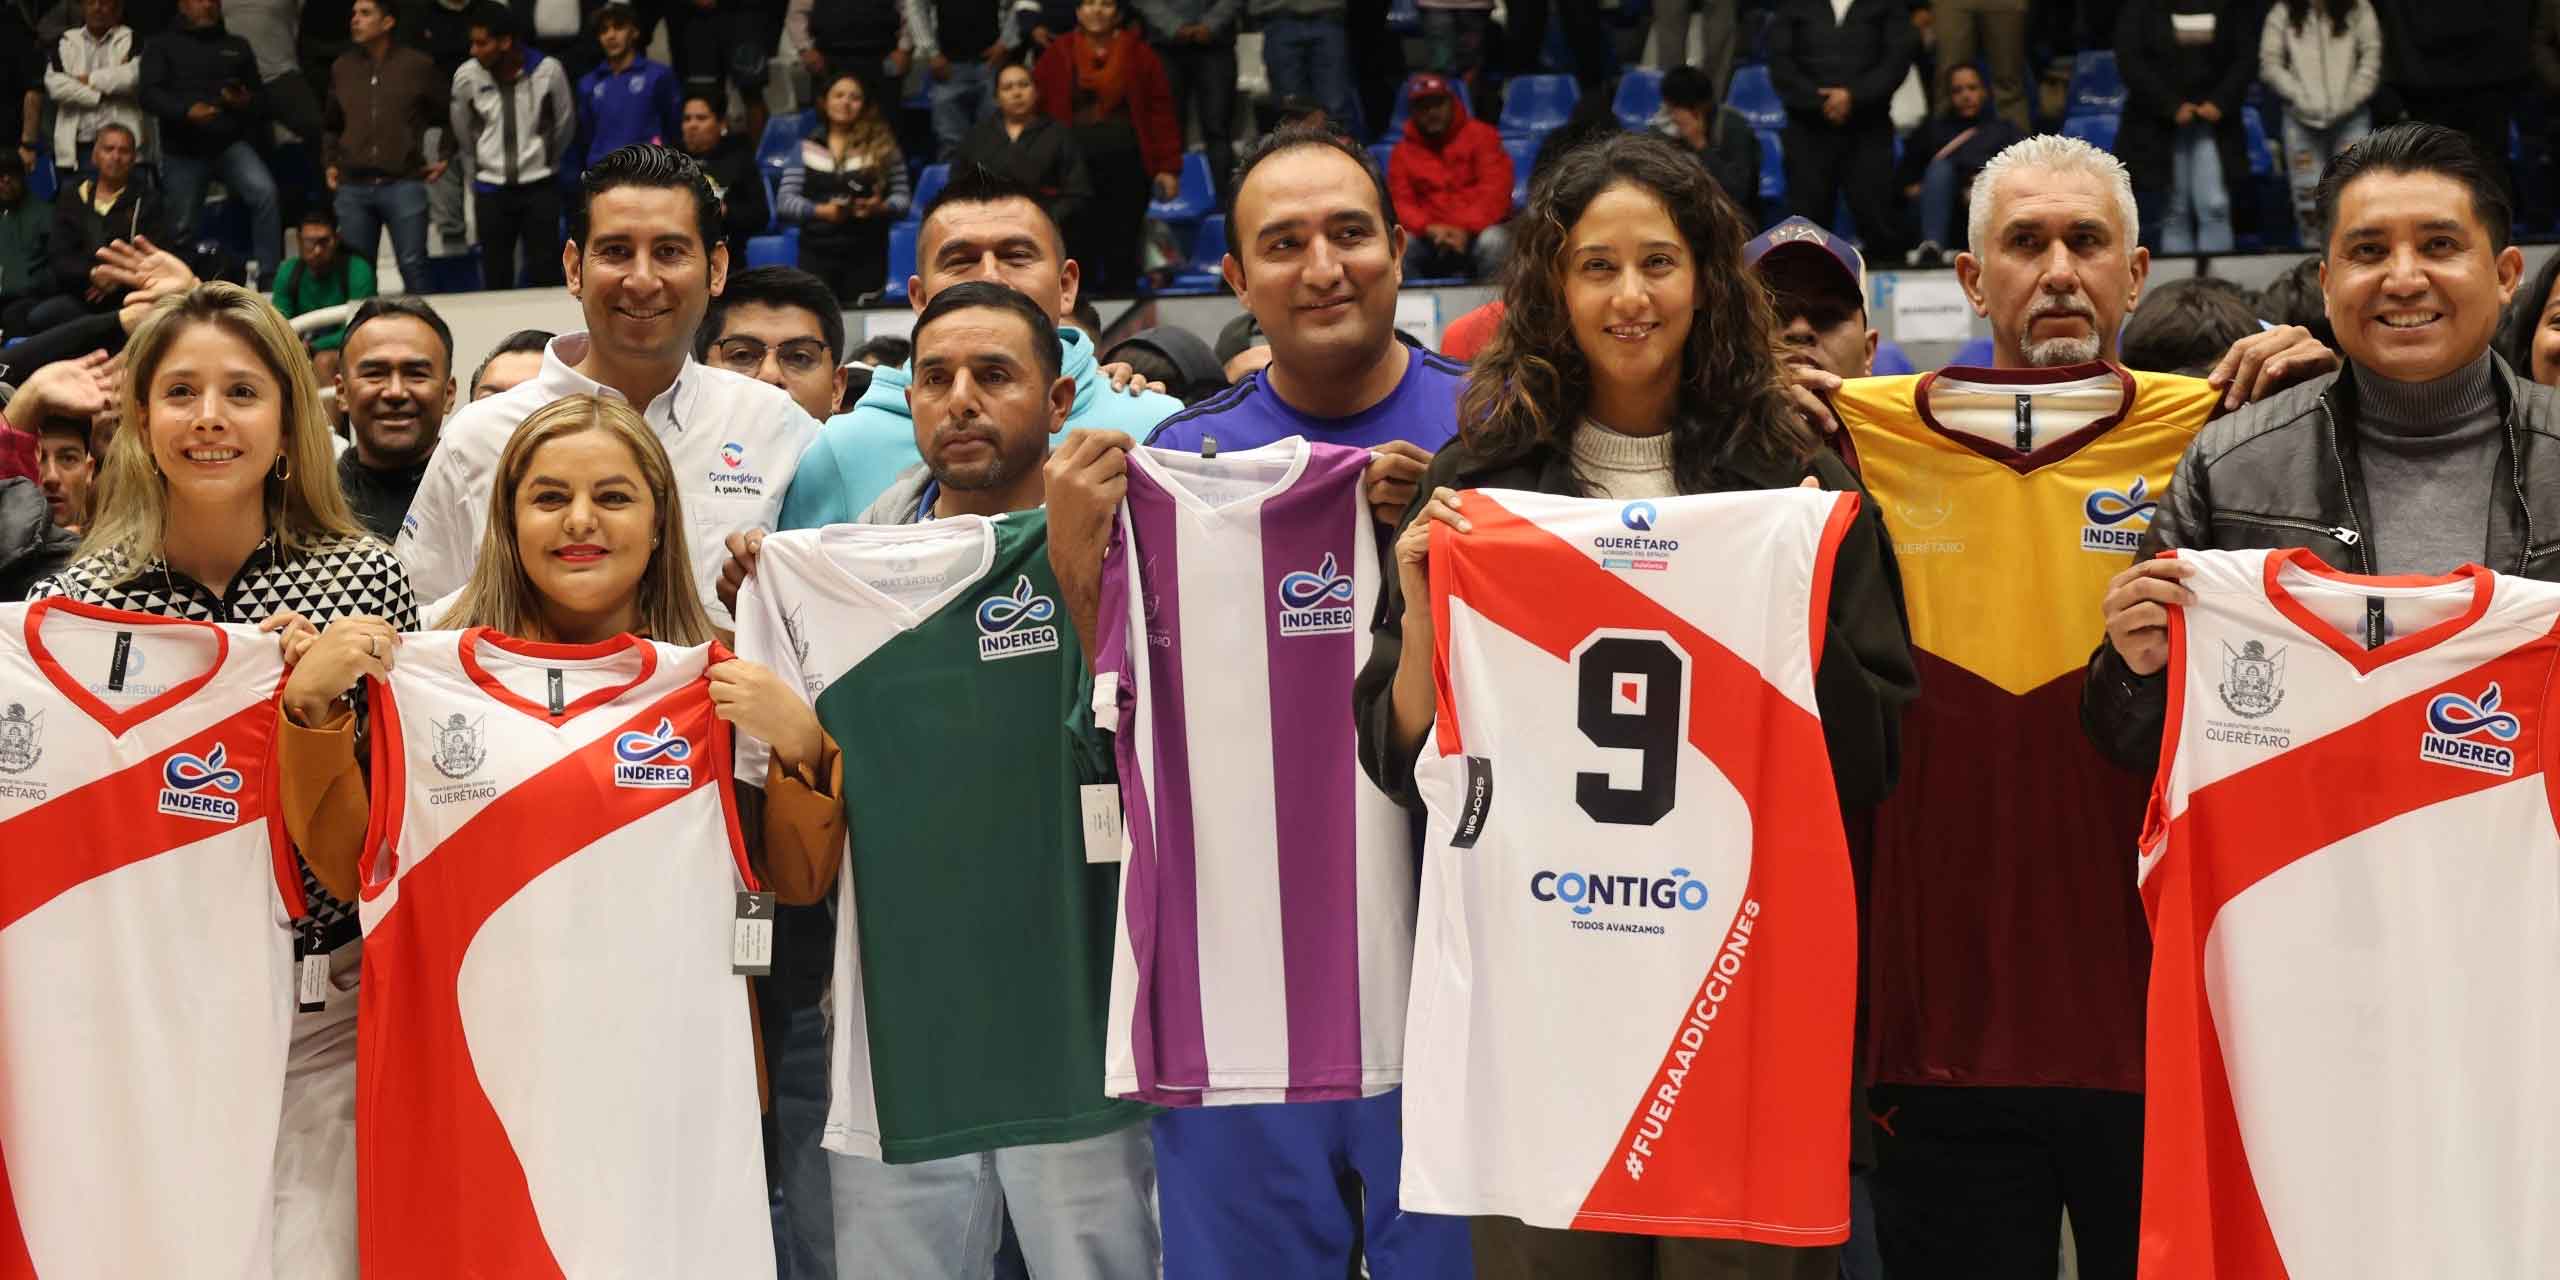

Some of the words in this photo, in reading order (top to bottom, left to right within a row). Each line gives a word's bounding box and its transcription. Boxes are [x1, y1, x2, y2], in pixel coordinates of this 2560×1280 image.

[1594, 536, 1679, 551] QUERÉTARO
[1282, 609, 1353, 628] INDEREQ
[981, 628, 1056, 653] INDEREQ
[1575, 636, 1683, 827] 9
[2206, 727, 2291, 749] QUERÉTARO
[2424, 735, 2511, 768] INDEREQ
[617, 765, 690, 781] INDEREQ
[161, 791, 236, 816] INDEREQ
[430, 786, 497, 805] QUERÉTARO
[1530, 867, 1709, 914] CONTIGO
[1571, 920, 1604, 932] TODOS
[1606, 922, 1666, 936] AVANZAMOS
[1625, 899, 1760, 1181] #FUERAADICCIONES
